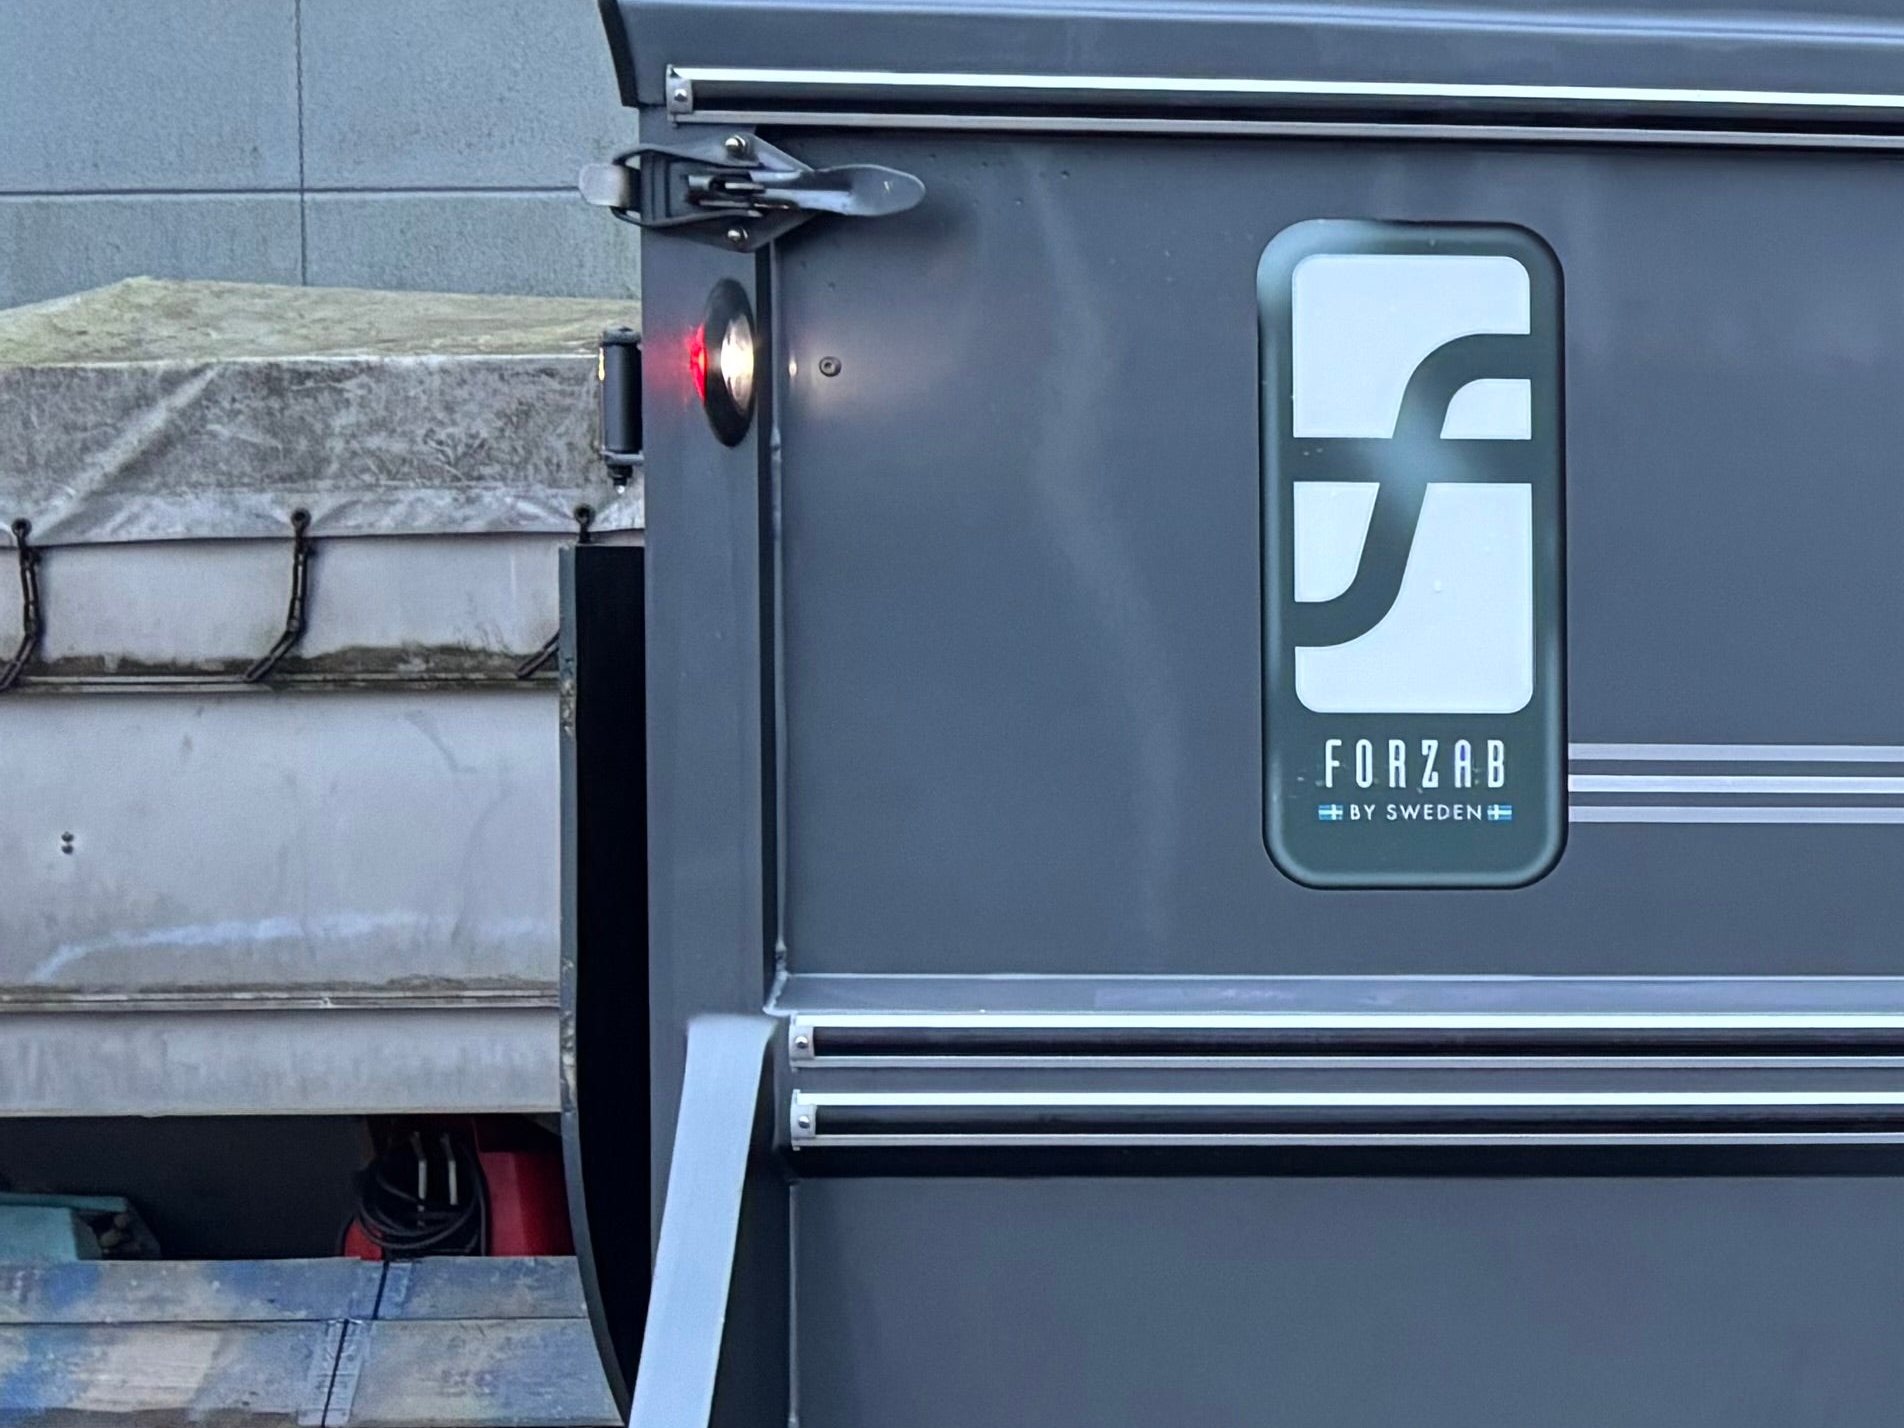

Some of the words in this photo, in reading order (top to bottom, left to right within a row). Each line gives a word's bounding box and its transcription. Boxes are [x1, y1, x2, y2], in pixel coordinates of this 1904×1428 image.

[1325, 738, 1505, 788] FORZAB
[1350, 803, 1376, 821] BY
[1386, 803, 1482, 821] SWEDEN
